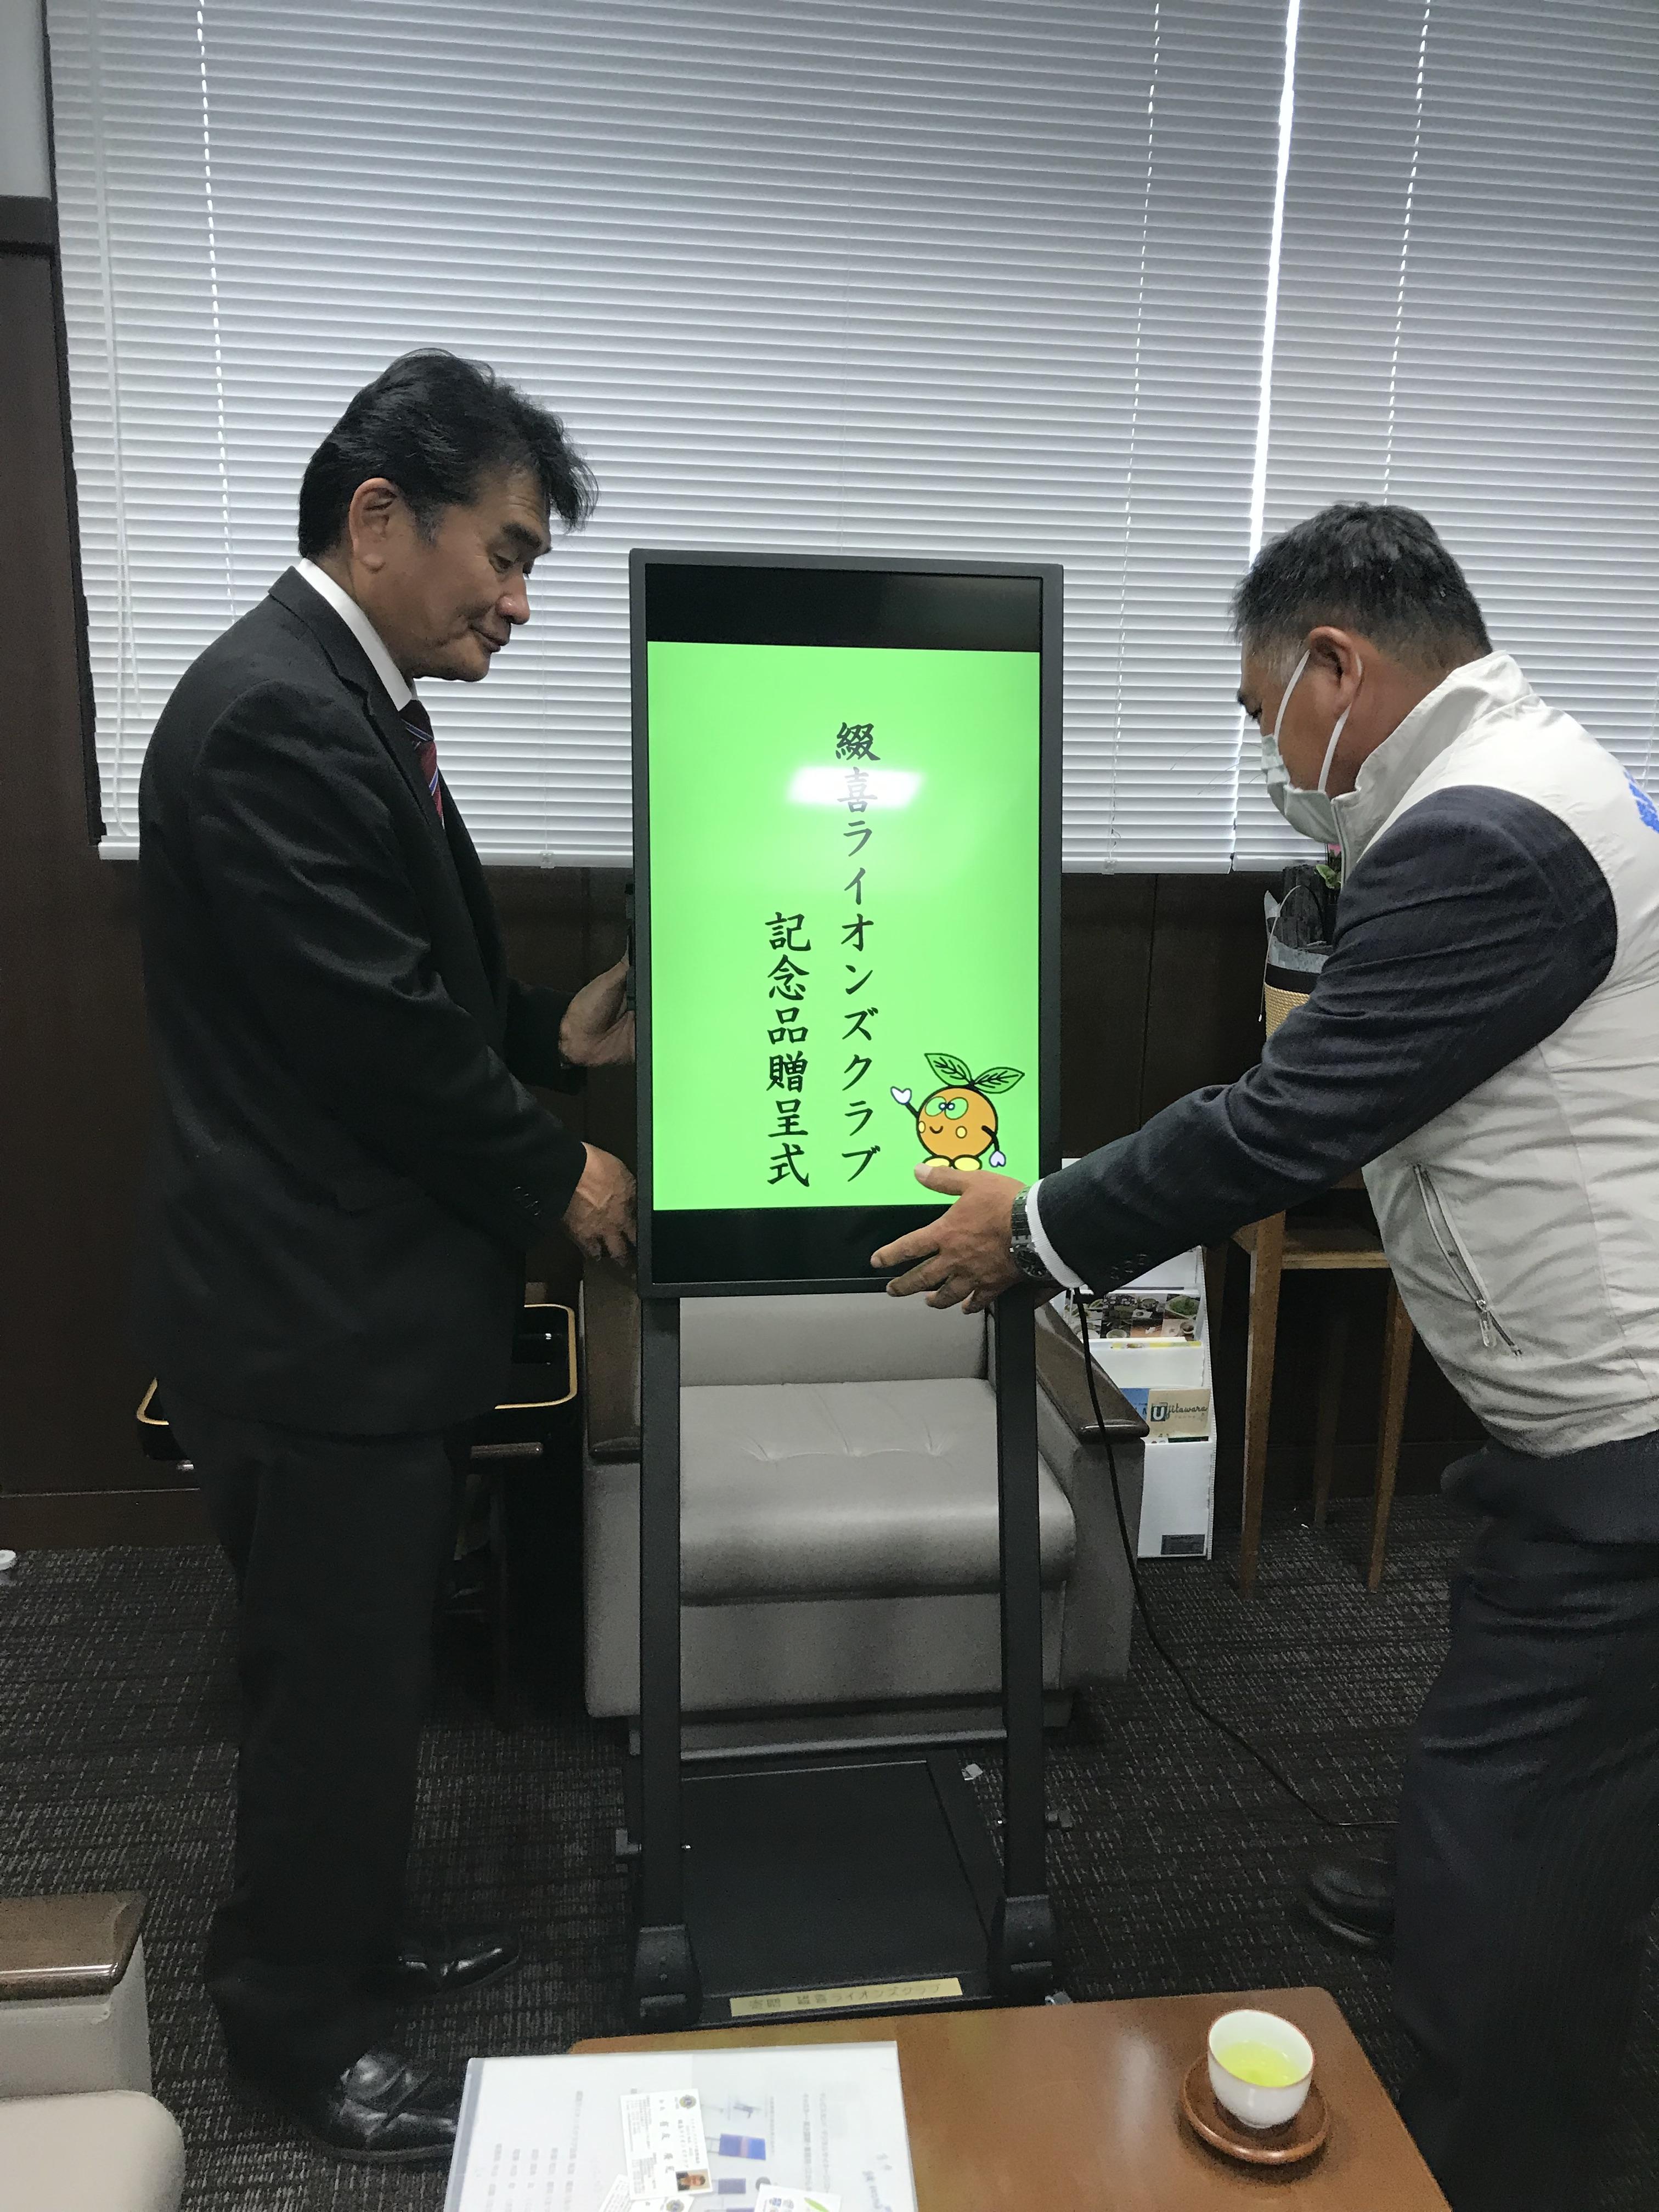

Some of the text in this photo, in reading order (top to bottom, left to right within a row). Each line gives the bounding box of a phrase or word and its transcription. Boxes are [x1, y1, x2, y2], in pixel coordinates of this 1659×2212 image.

[765, 912, 811, 1187] 記念品贈呈式
[835, 722, 881, 1182] 綴喜ライオンズクラブ
